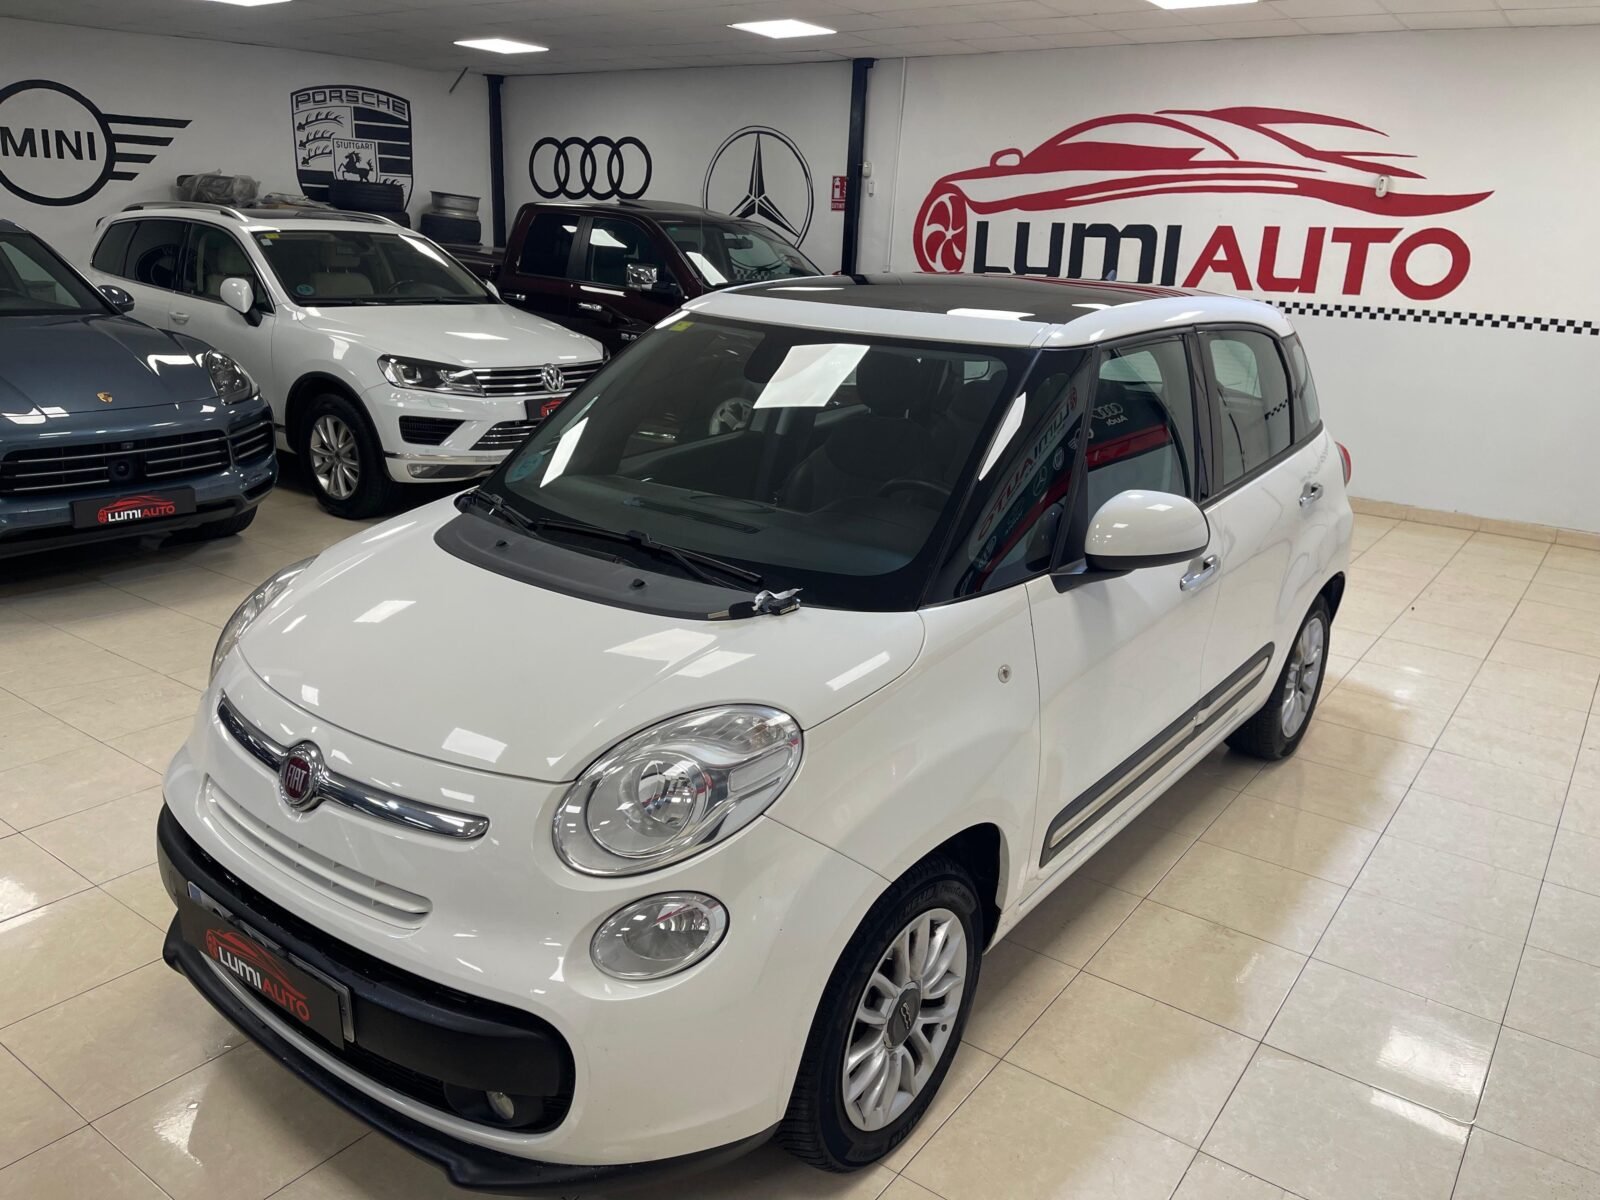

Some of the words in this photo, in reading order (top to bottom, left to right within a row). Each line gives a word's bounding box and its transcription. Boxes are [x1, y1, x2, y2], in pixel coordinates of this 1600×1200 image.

[294, 89, 407, 117] PORSCHE
[0, 126, 97, 161] MINI
[335, 140, 374, 151] STUTTGART
[973, 220, 1471, 301] LUMIAUTO
[108, 505, 175, 522] LUMIAUTO
[285, 763, 308, 793] FIAT
[218, 945, 312, 1022] LUMIAUTO
